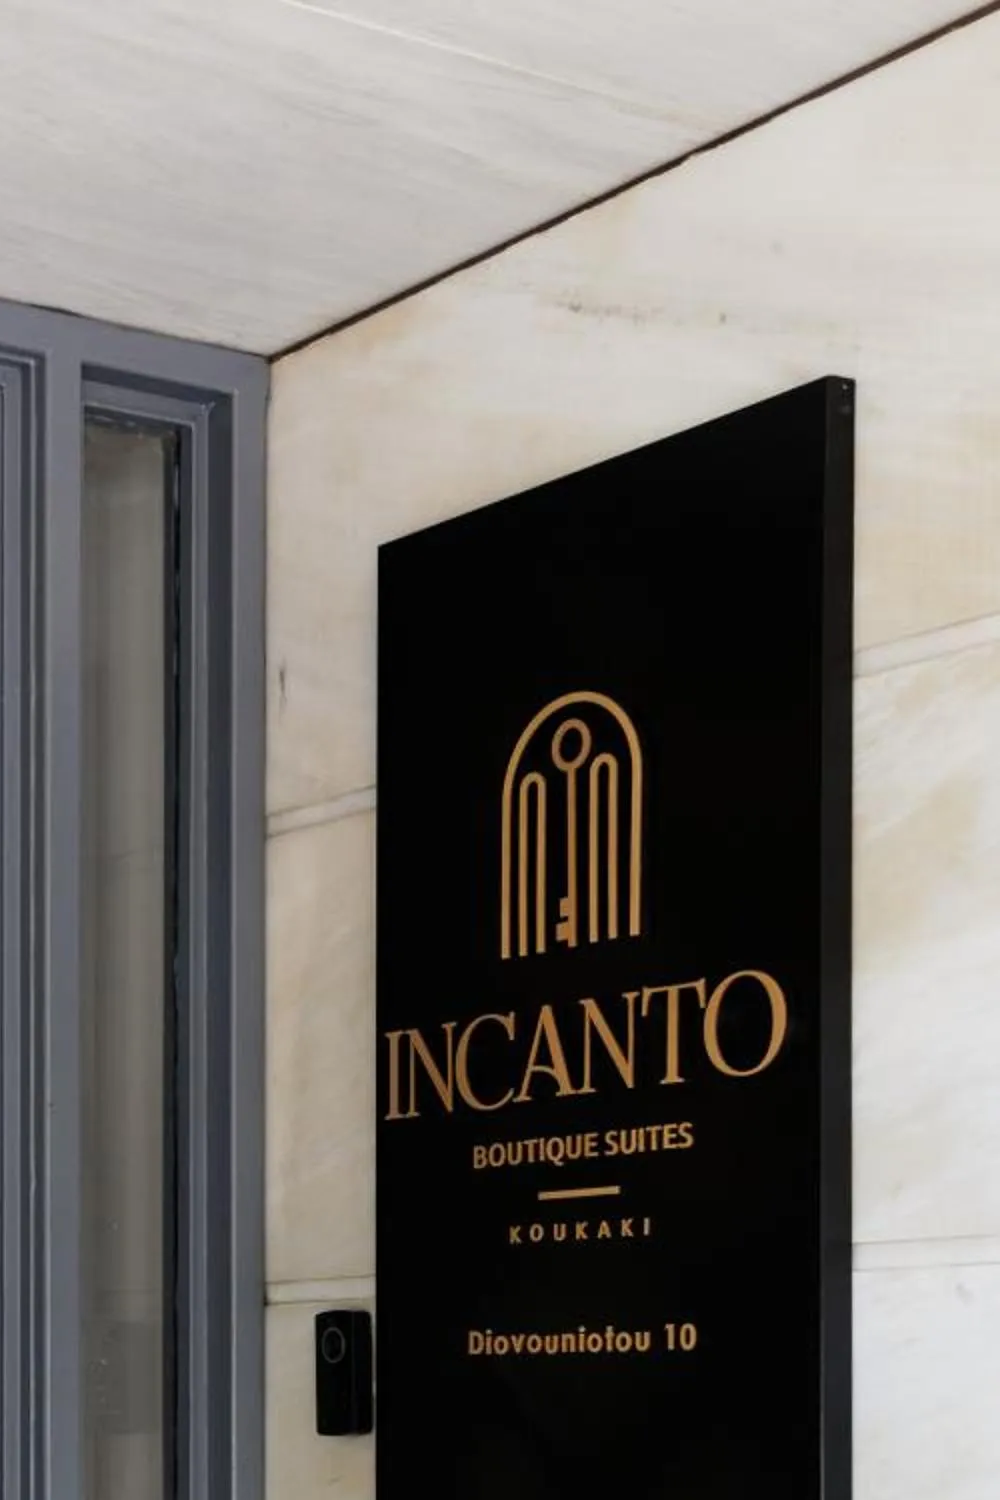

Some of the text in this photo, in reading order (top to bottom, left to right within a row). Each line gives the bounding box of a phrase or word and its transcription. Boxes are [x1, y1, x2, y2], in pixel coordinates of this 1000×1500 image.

[384, 969, 789, 1121] INCANTO
[473, 1121, 695, 1169] BOUTIQUE SUITES
[509, 1217, 651, 1245] KOUKAKI
[468, 1323, 698, 1355] Diovouniotou 10
